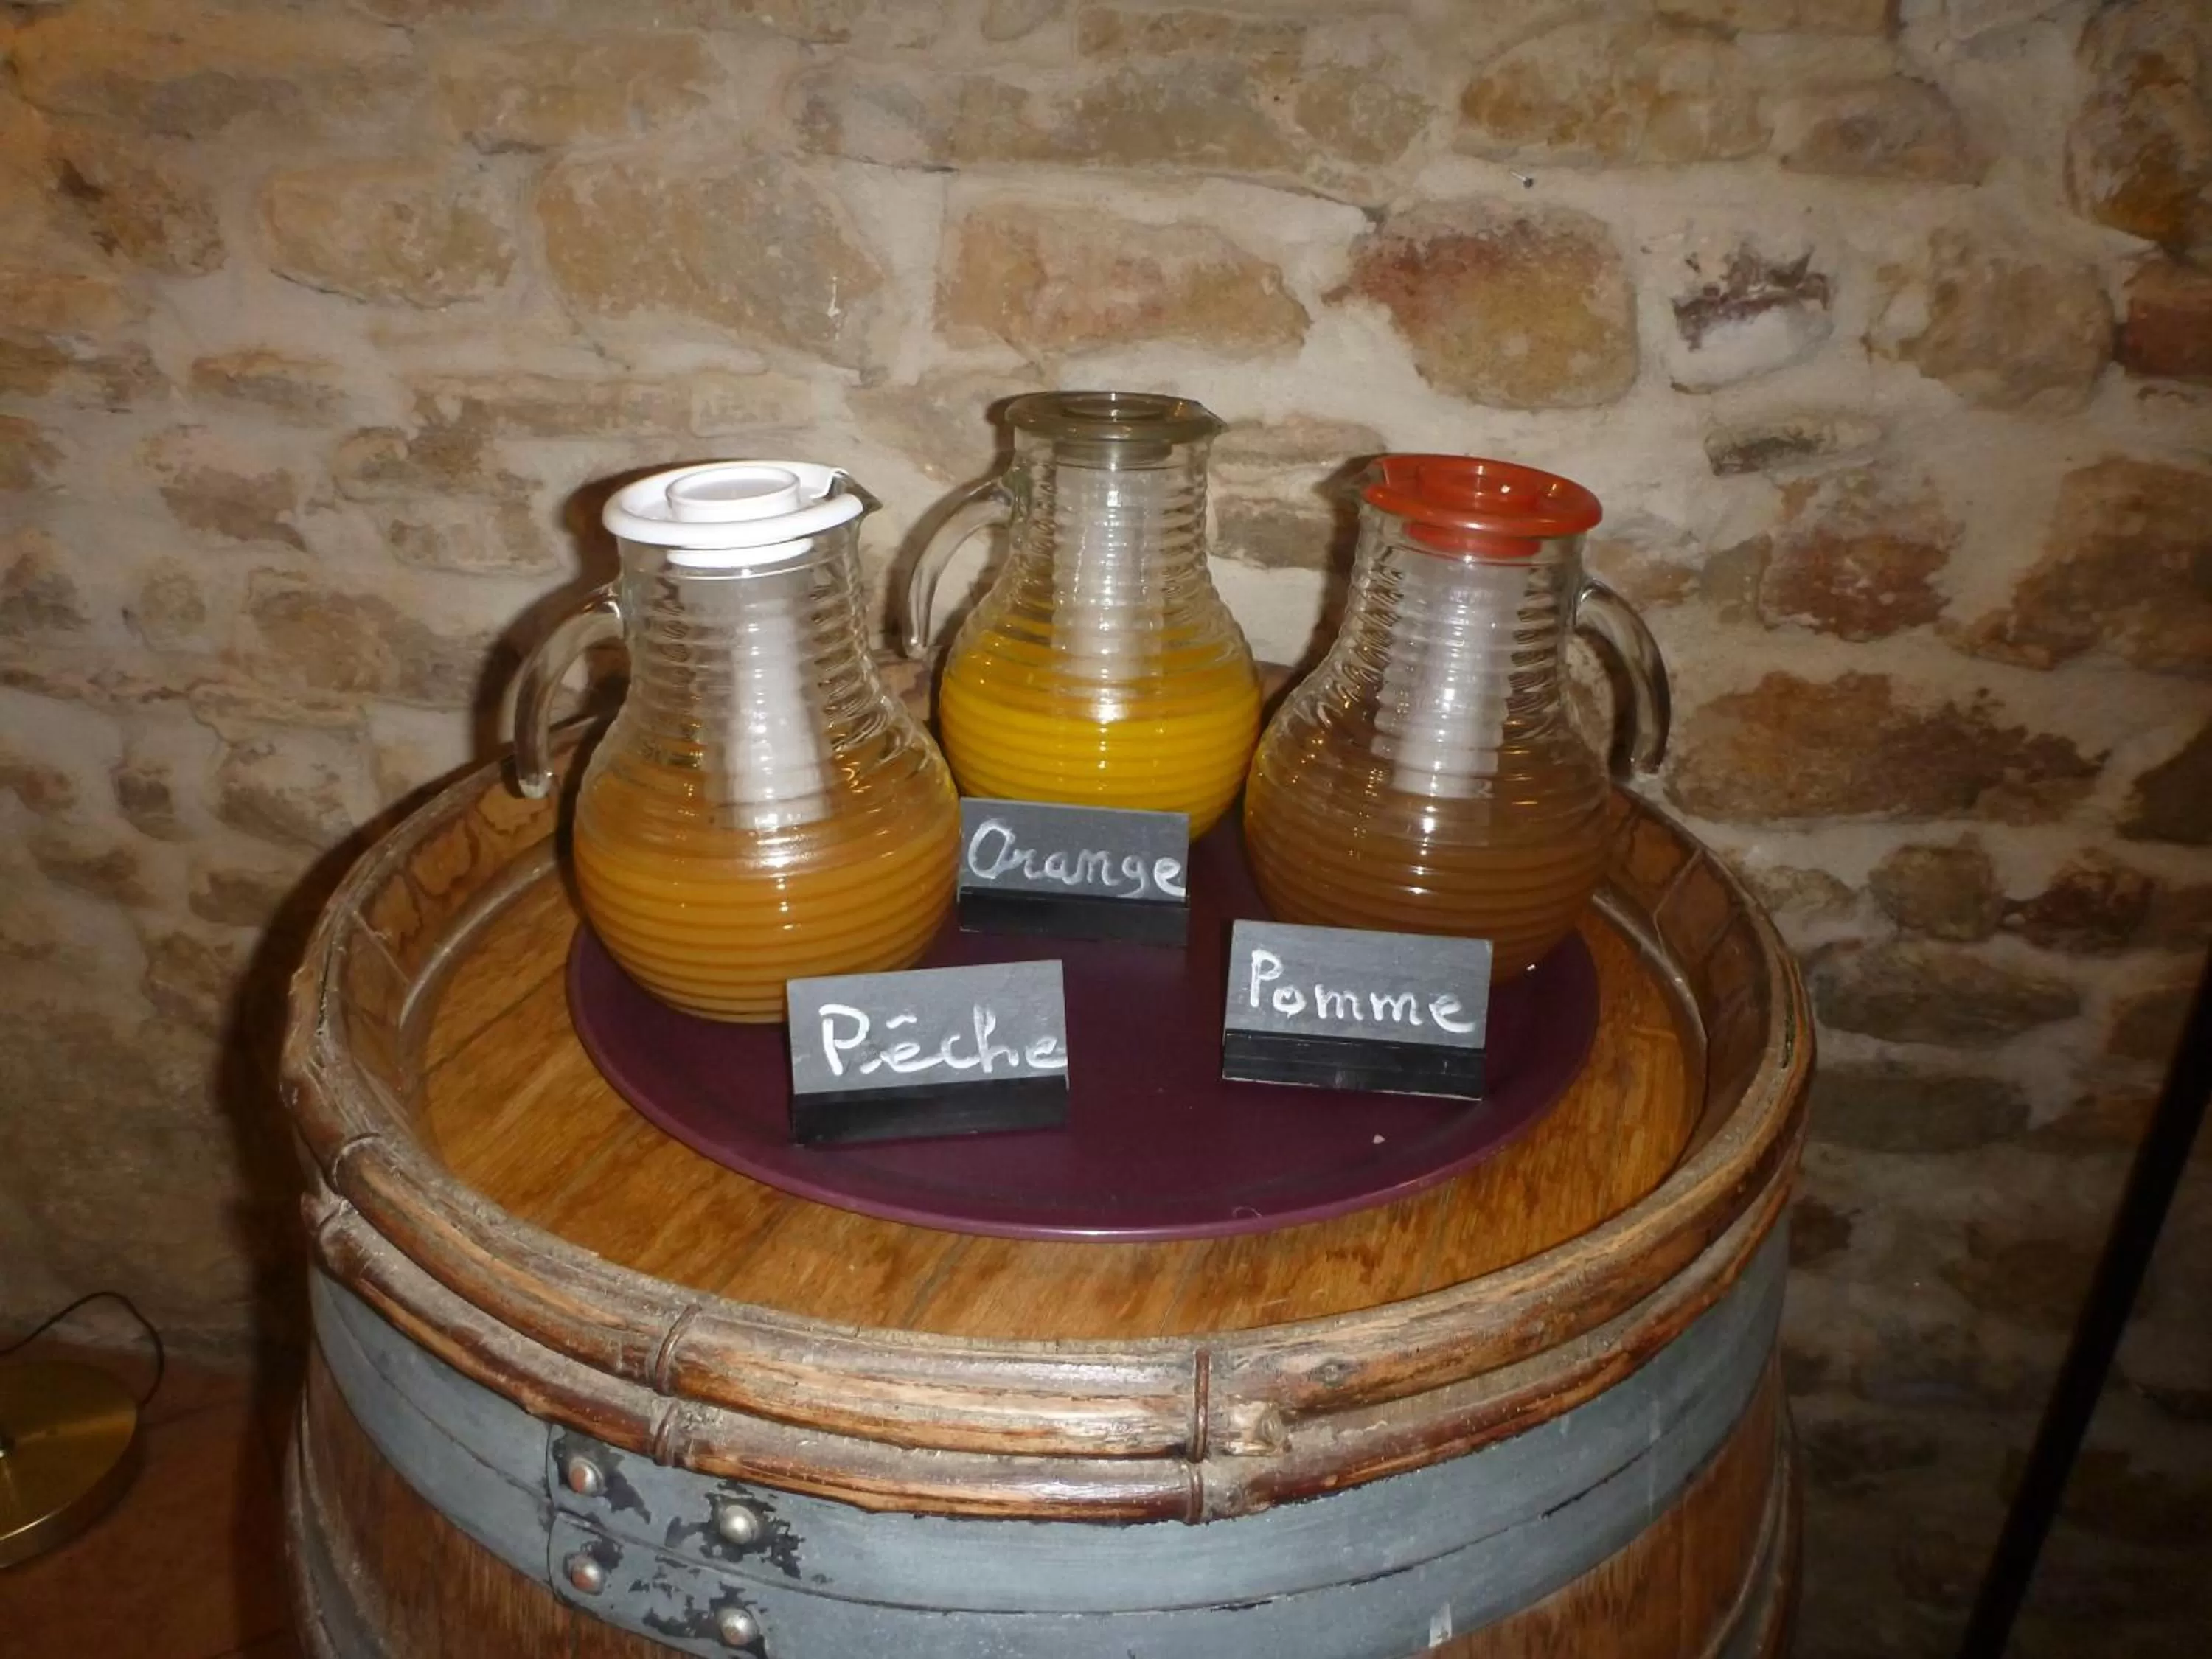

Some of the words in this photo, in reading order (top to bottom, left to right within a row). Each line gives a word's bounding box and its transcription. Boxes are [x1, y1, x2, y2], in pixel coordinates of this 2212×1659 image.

[967, 818, 1186, 899] Orange
[1249, 947, 1475, 1033] Pomme
[818, 1002, 1068, 1076] Pêche
